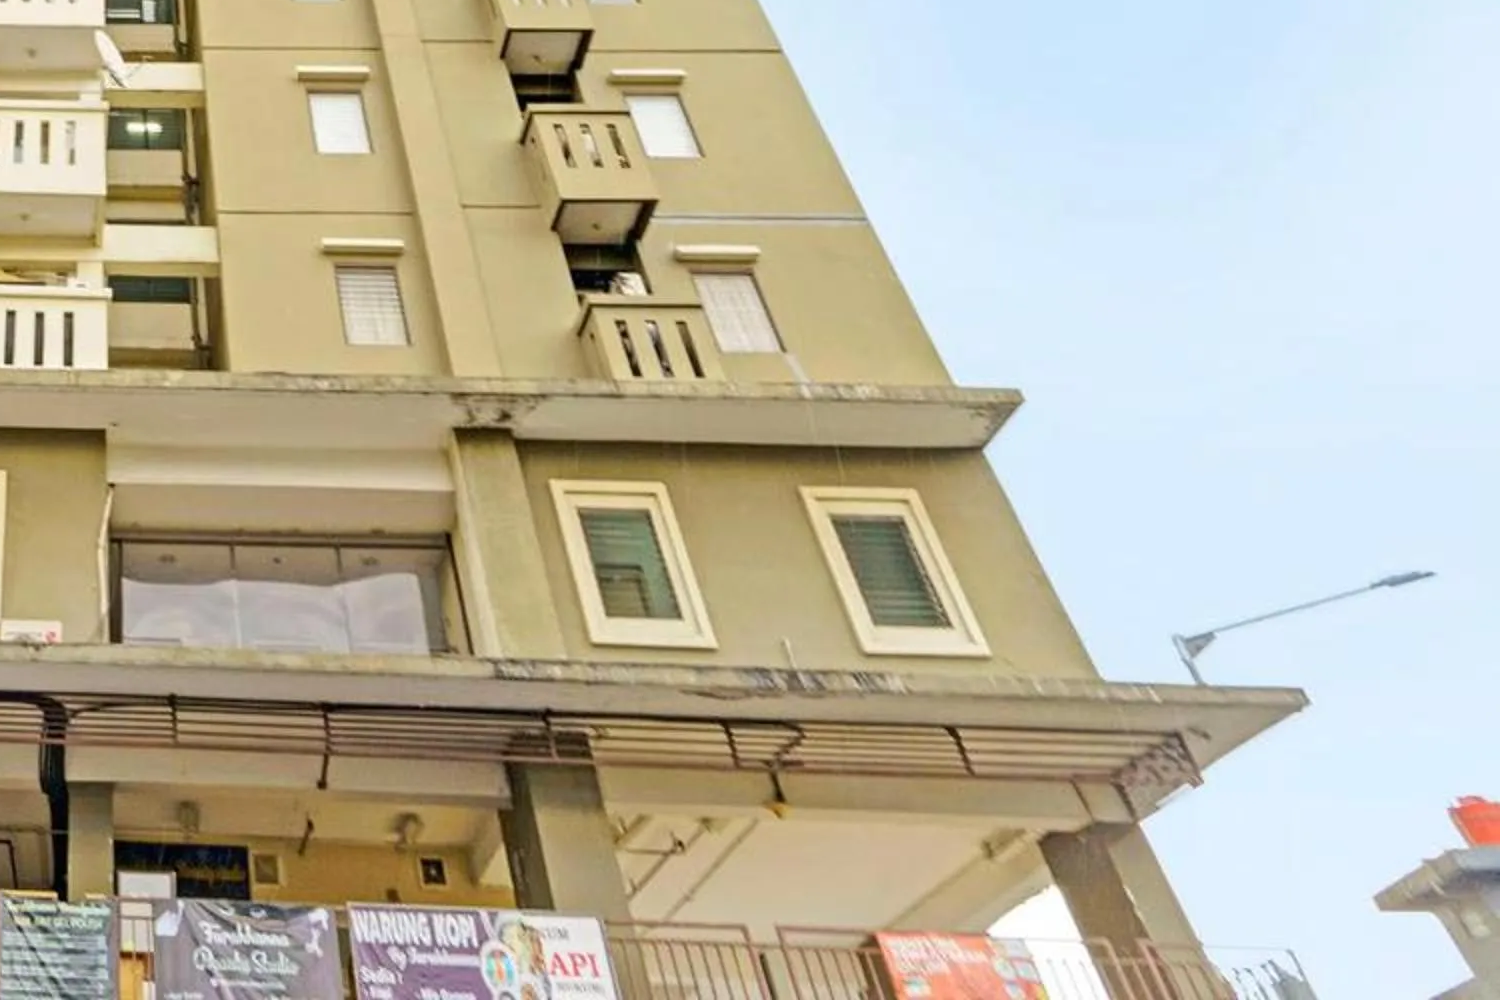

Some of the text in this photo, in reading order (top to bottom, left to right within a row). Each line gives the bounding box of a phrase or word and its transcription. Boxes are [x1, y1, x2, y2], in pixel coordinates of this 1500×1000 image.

[350, 909, 479, 949] WARUNG KOPI
[549, 951, 601, 977] API
